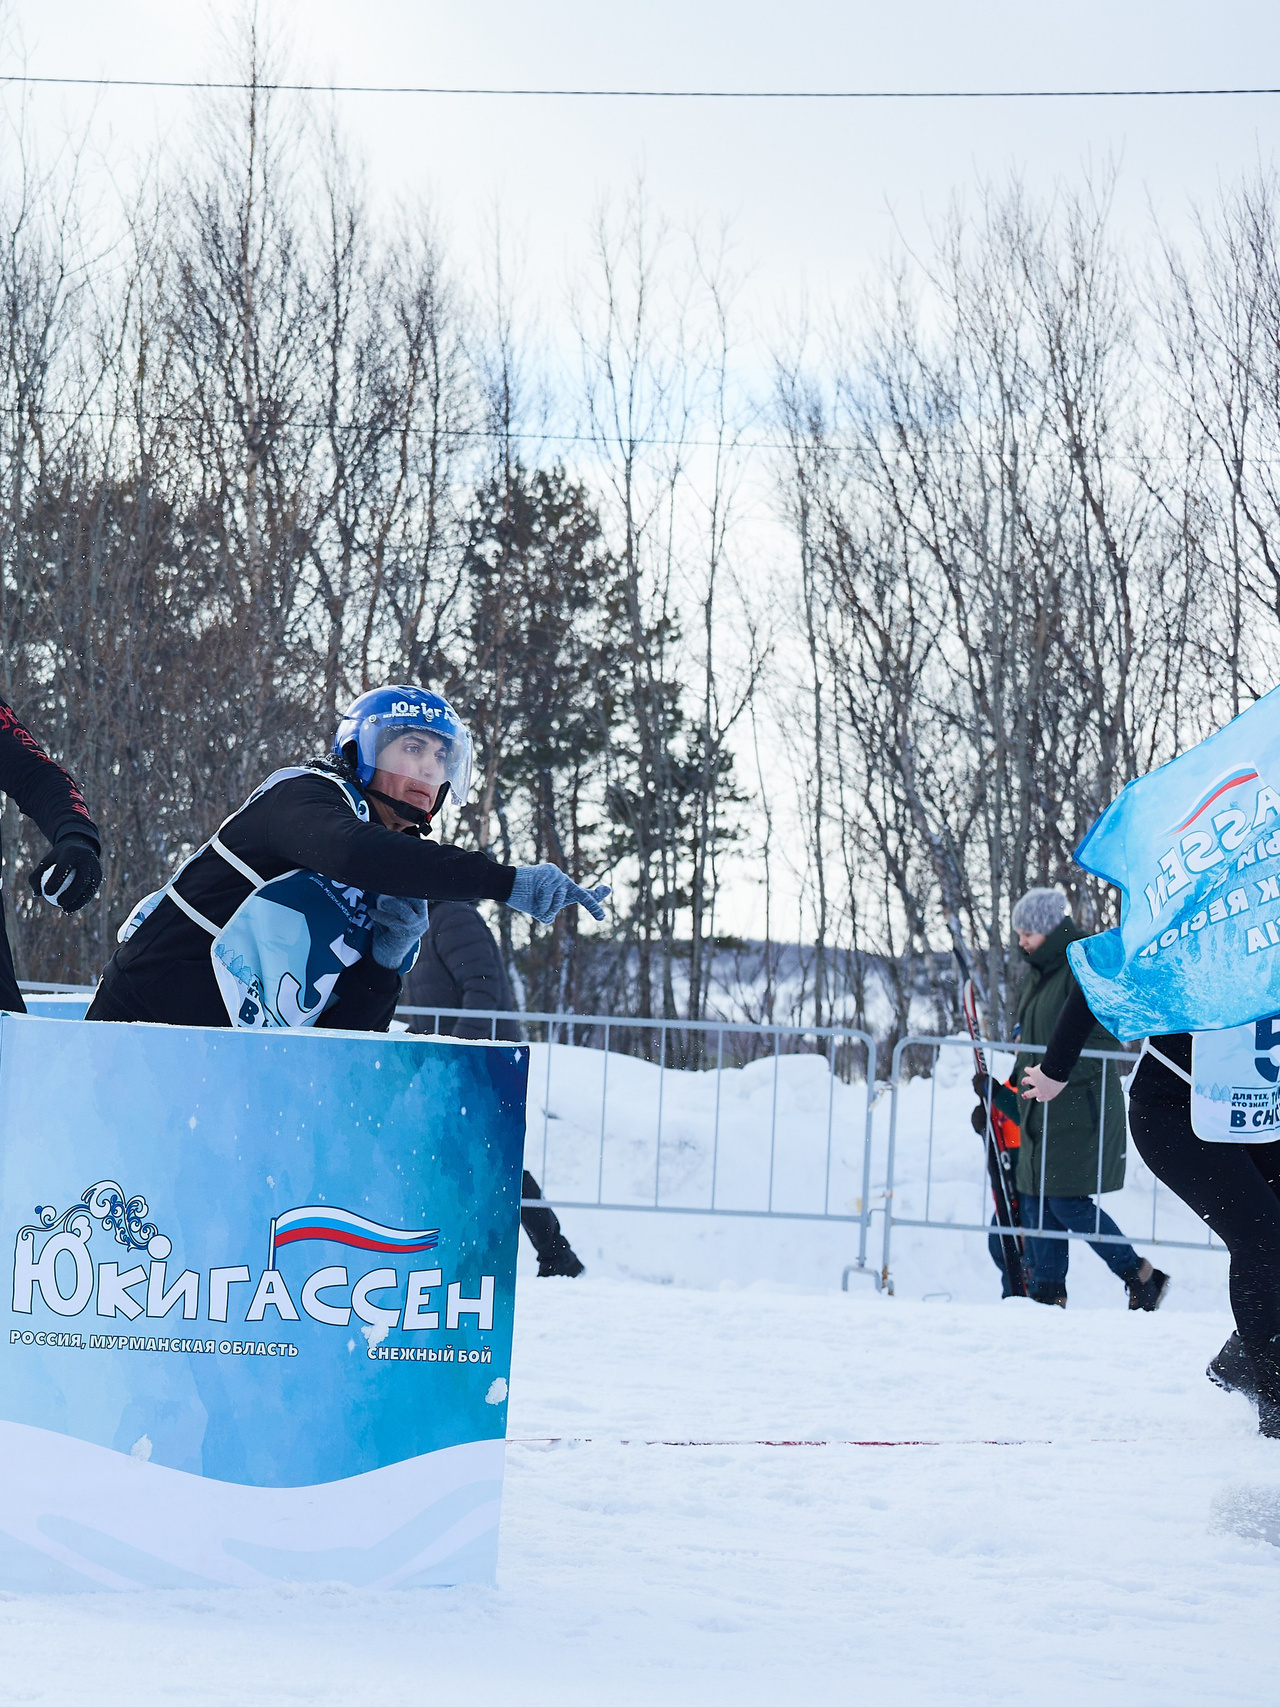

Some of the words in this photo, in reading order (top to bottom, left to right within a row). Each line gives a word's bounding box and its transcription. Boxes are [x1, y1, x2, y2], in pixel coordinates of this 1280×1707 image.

[1232, 1092, 1252, 1101] ДЛЯ
[1230, 1109, 1247, 1128] В
[1252, 1108, 1277, 1127] СН
[9, 1329, 87, 1349] РОССИЯ,
[89, 1334, 216, 1354] МУРМАНСКАЯ
[218, 1340, 299, 1357] ОБЛАСТЬ
[367, 1345, 455, 1362] СНЕЖНЫЙ
[457, 1346, 493, 1364] БОЙ
